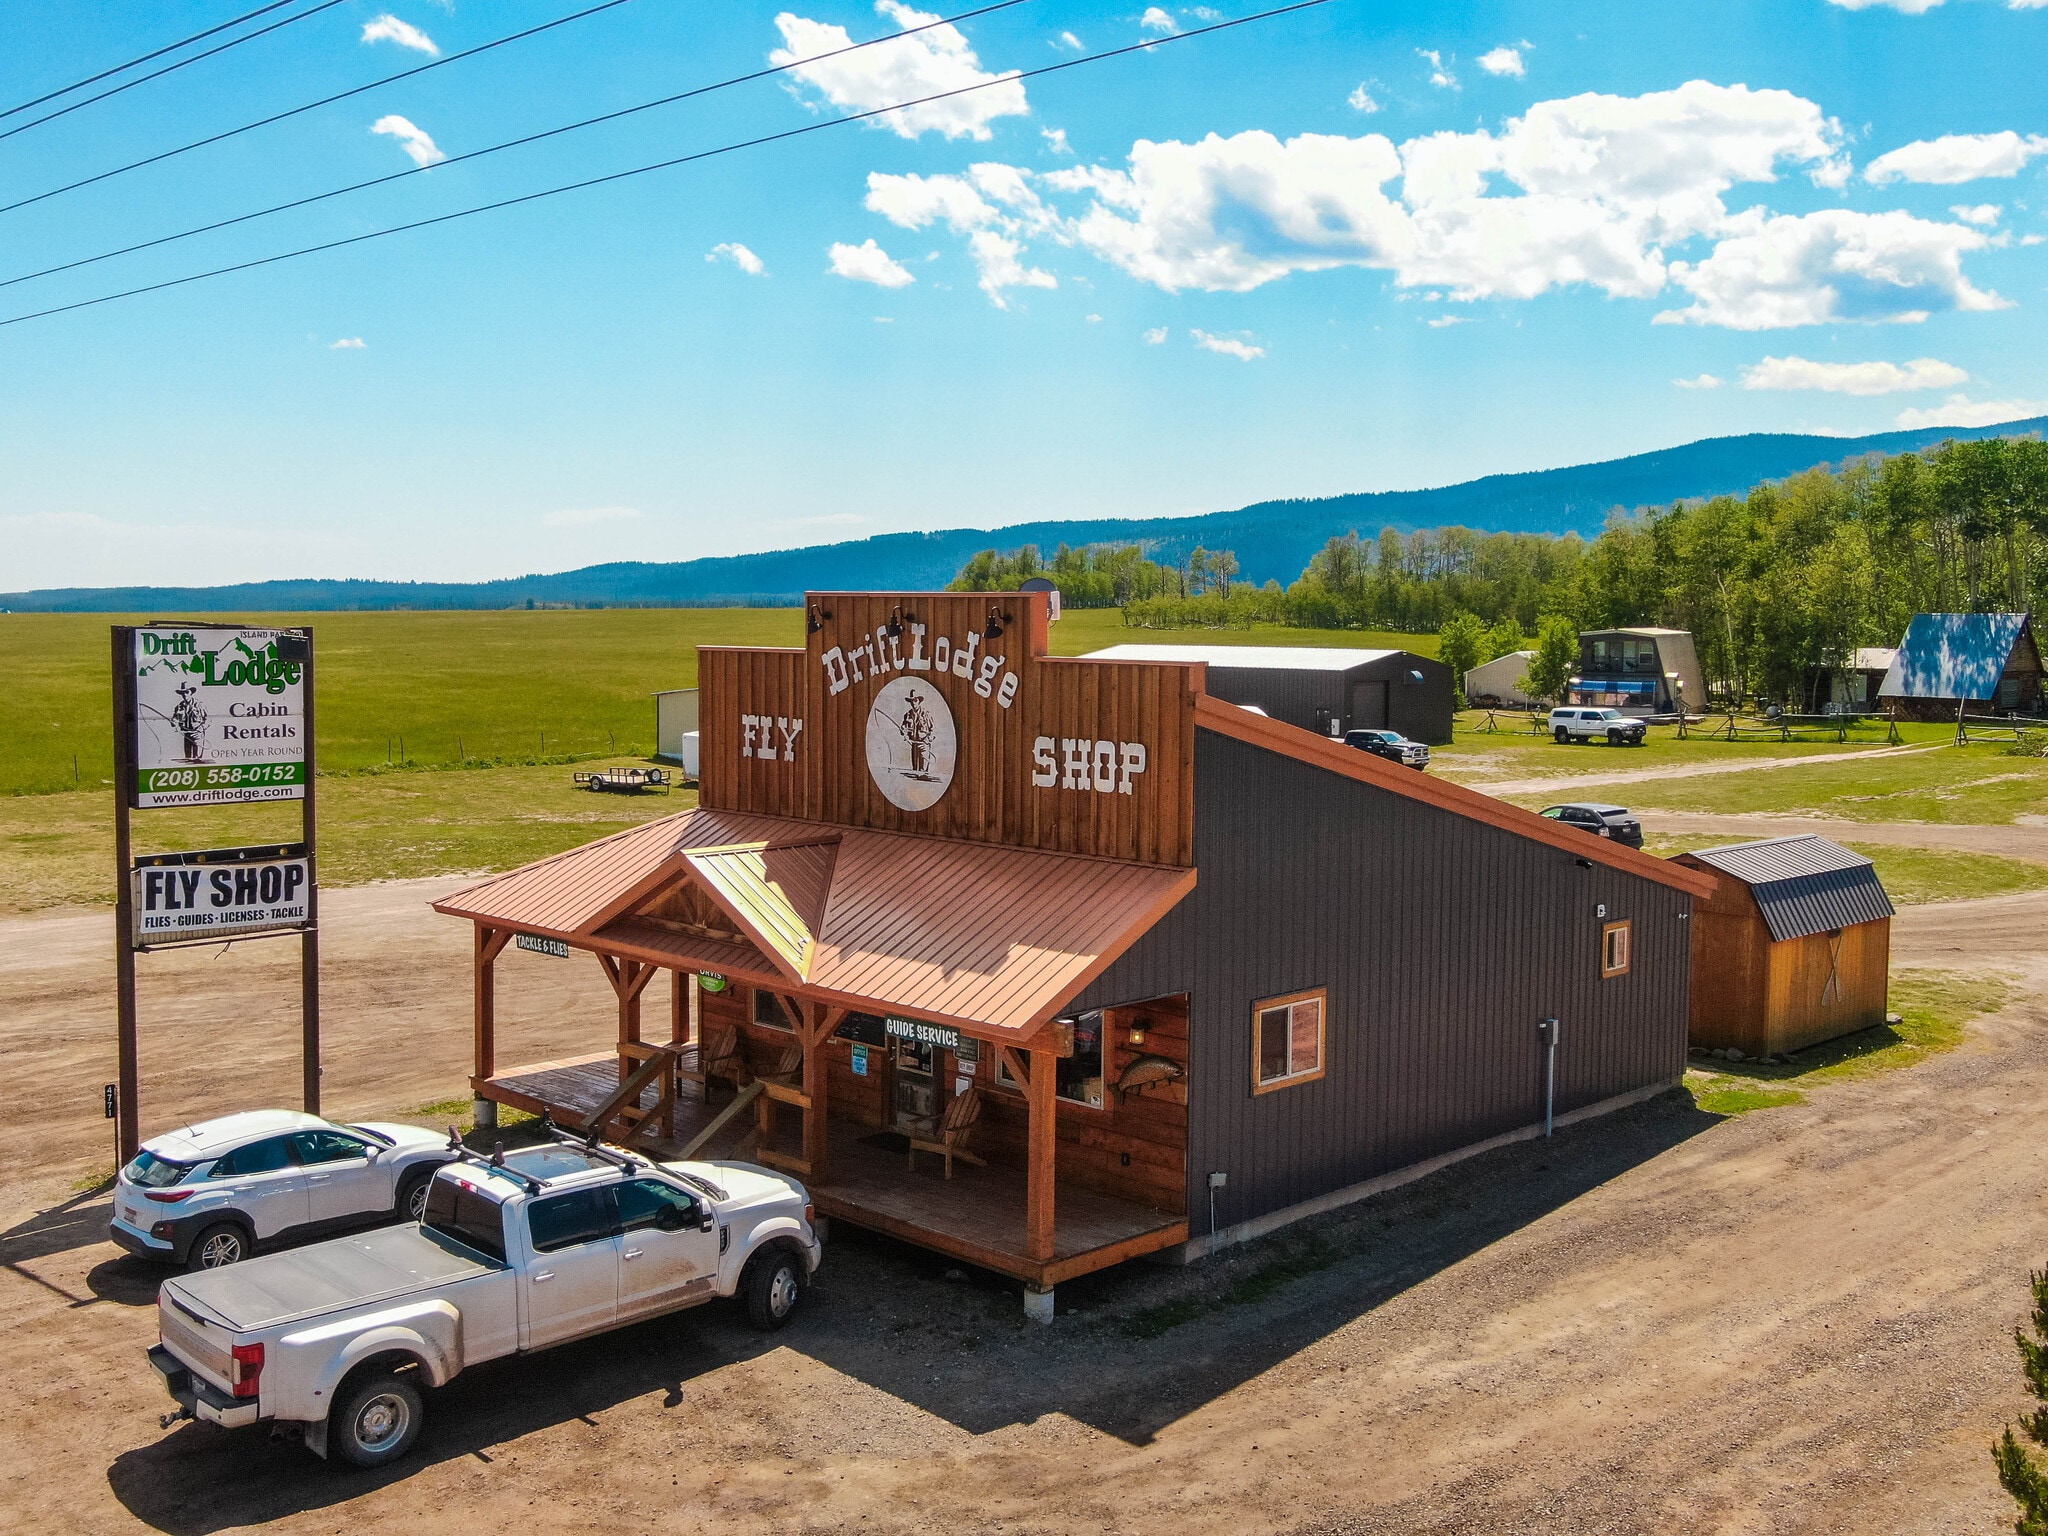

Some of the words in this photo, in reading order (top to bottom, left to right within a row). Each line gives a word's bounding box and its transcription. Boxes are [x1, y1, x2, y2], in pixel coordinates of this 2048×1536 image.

[141, 632, 197, 656] Drift
[240, 631, 268, 639] ISLAND
[201, 651, 301, 695] Lodge
[229, 702, 288, 718] Cabin
[223, 723, 296, 740] Rentals
[211, 748, 238, 759] OPEN
[240, 747, 264, 757] YEAR
[267, 746, 303, 756] ROUND
[741, 714, 803, 763] FLY
[1031, 735, 1146, 796] SHOP
[149, 769, 200, 791] (208)
[206, 765, 295, 784] 558-0152
[152, 786, 293, 804] www.driftlodge.com
[145, 869, 201, 911] FLY
[209, 864, 304, 908] SHOP
[145, 916, 171, 928] FLIES
[177, 913, 214, 927] GUIDES
[220, 909, 265, 923] LICENSES
[270, 906, 304, 919] TACKLE
[516, 935, 542, 951] TACKLE
[542, 940, 549, 953] &
[549, 940, 568, 957] FLIES
[886, 1018, 915, 1038] GUIDE
[916, 1024, 959, 1047] SERVICE
